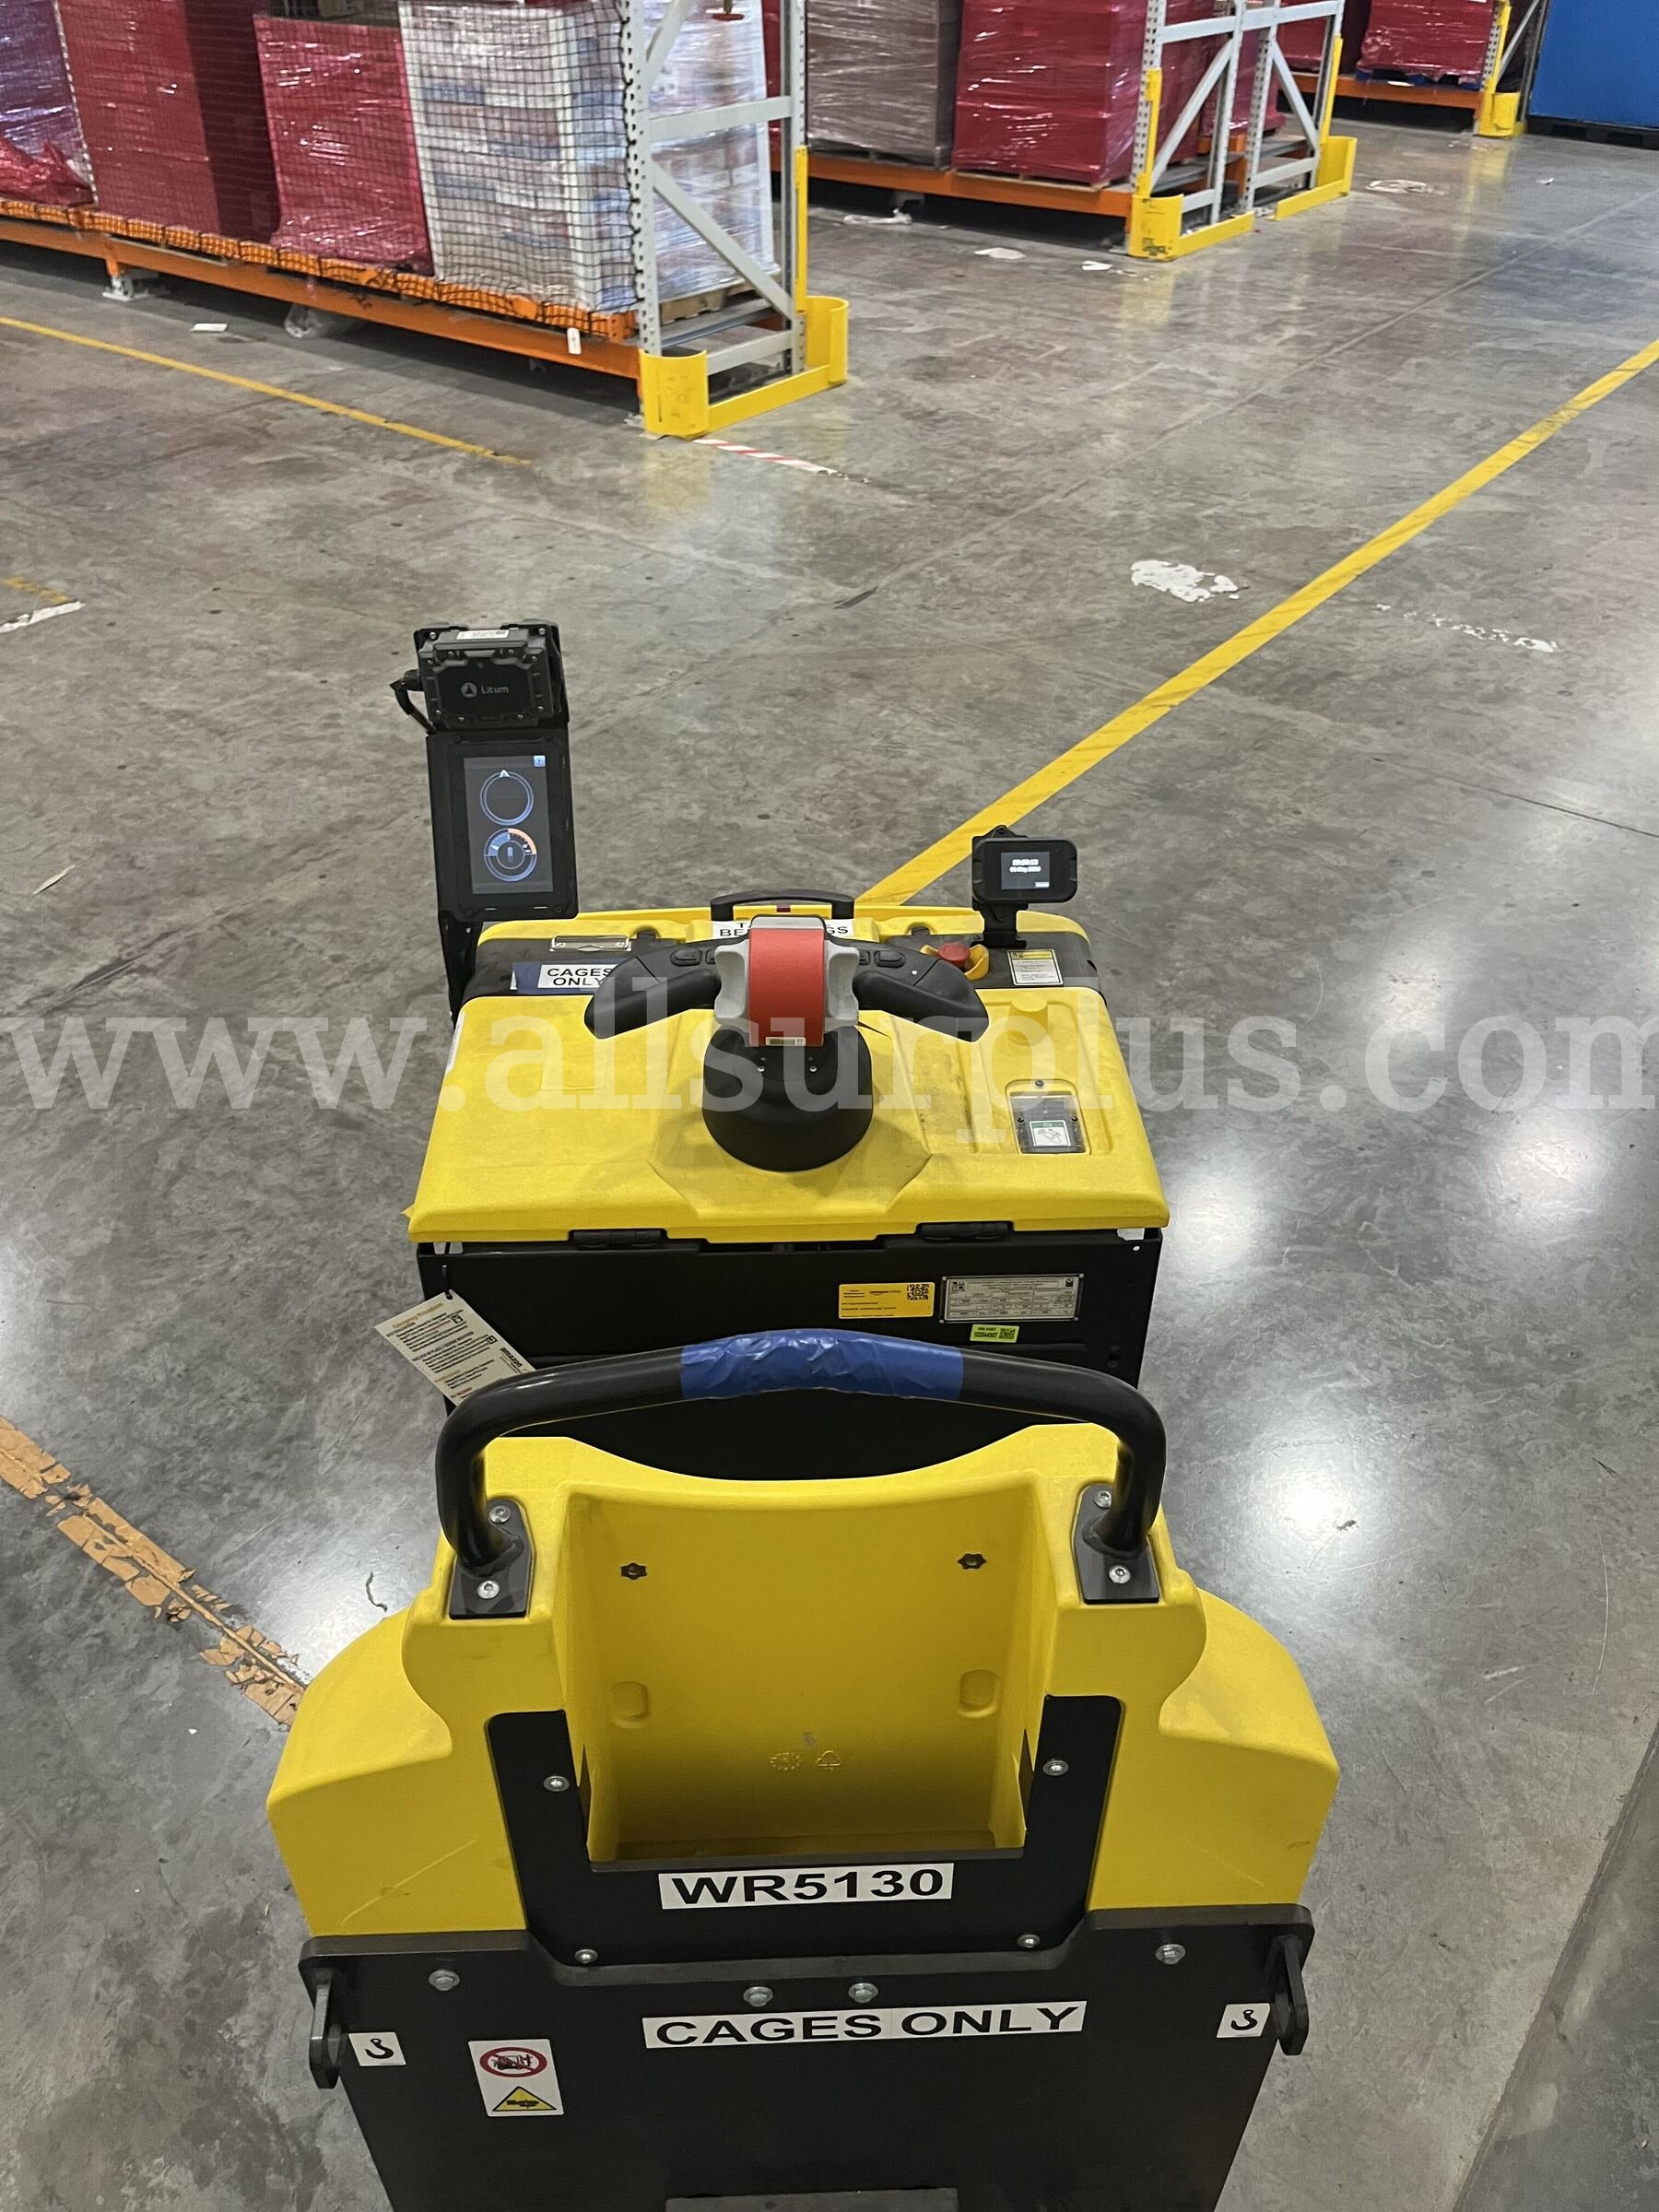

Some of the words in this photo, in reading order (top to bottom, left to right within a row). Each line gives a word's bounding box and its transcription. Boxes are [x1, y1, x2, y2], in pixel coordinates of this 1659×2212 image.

[547, 968, 613, 977] CAGES
[553, 977, 606, 986] ONLY
[671, 1868, 944, 1905] WR5130
[655, 2014, 883, 2045] CAGES
[900, 2006, 1079, 2036] ONLY
